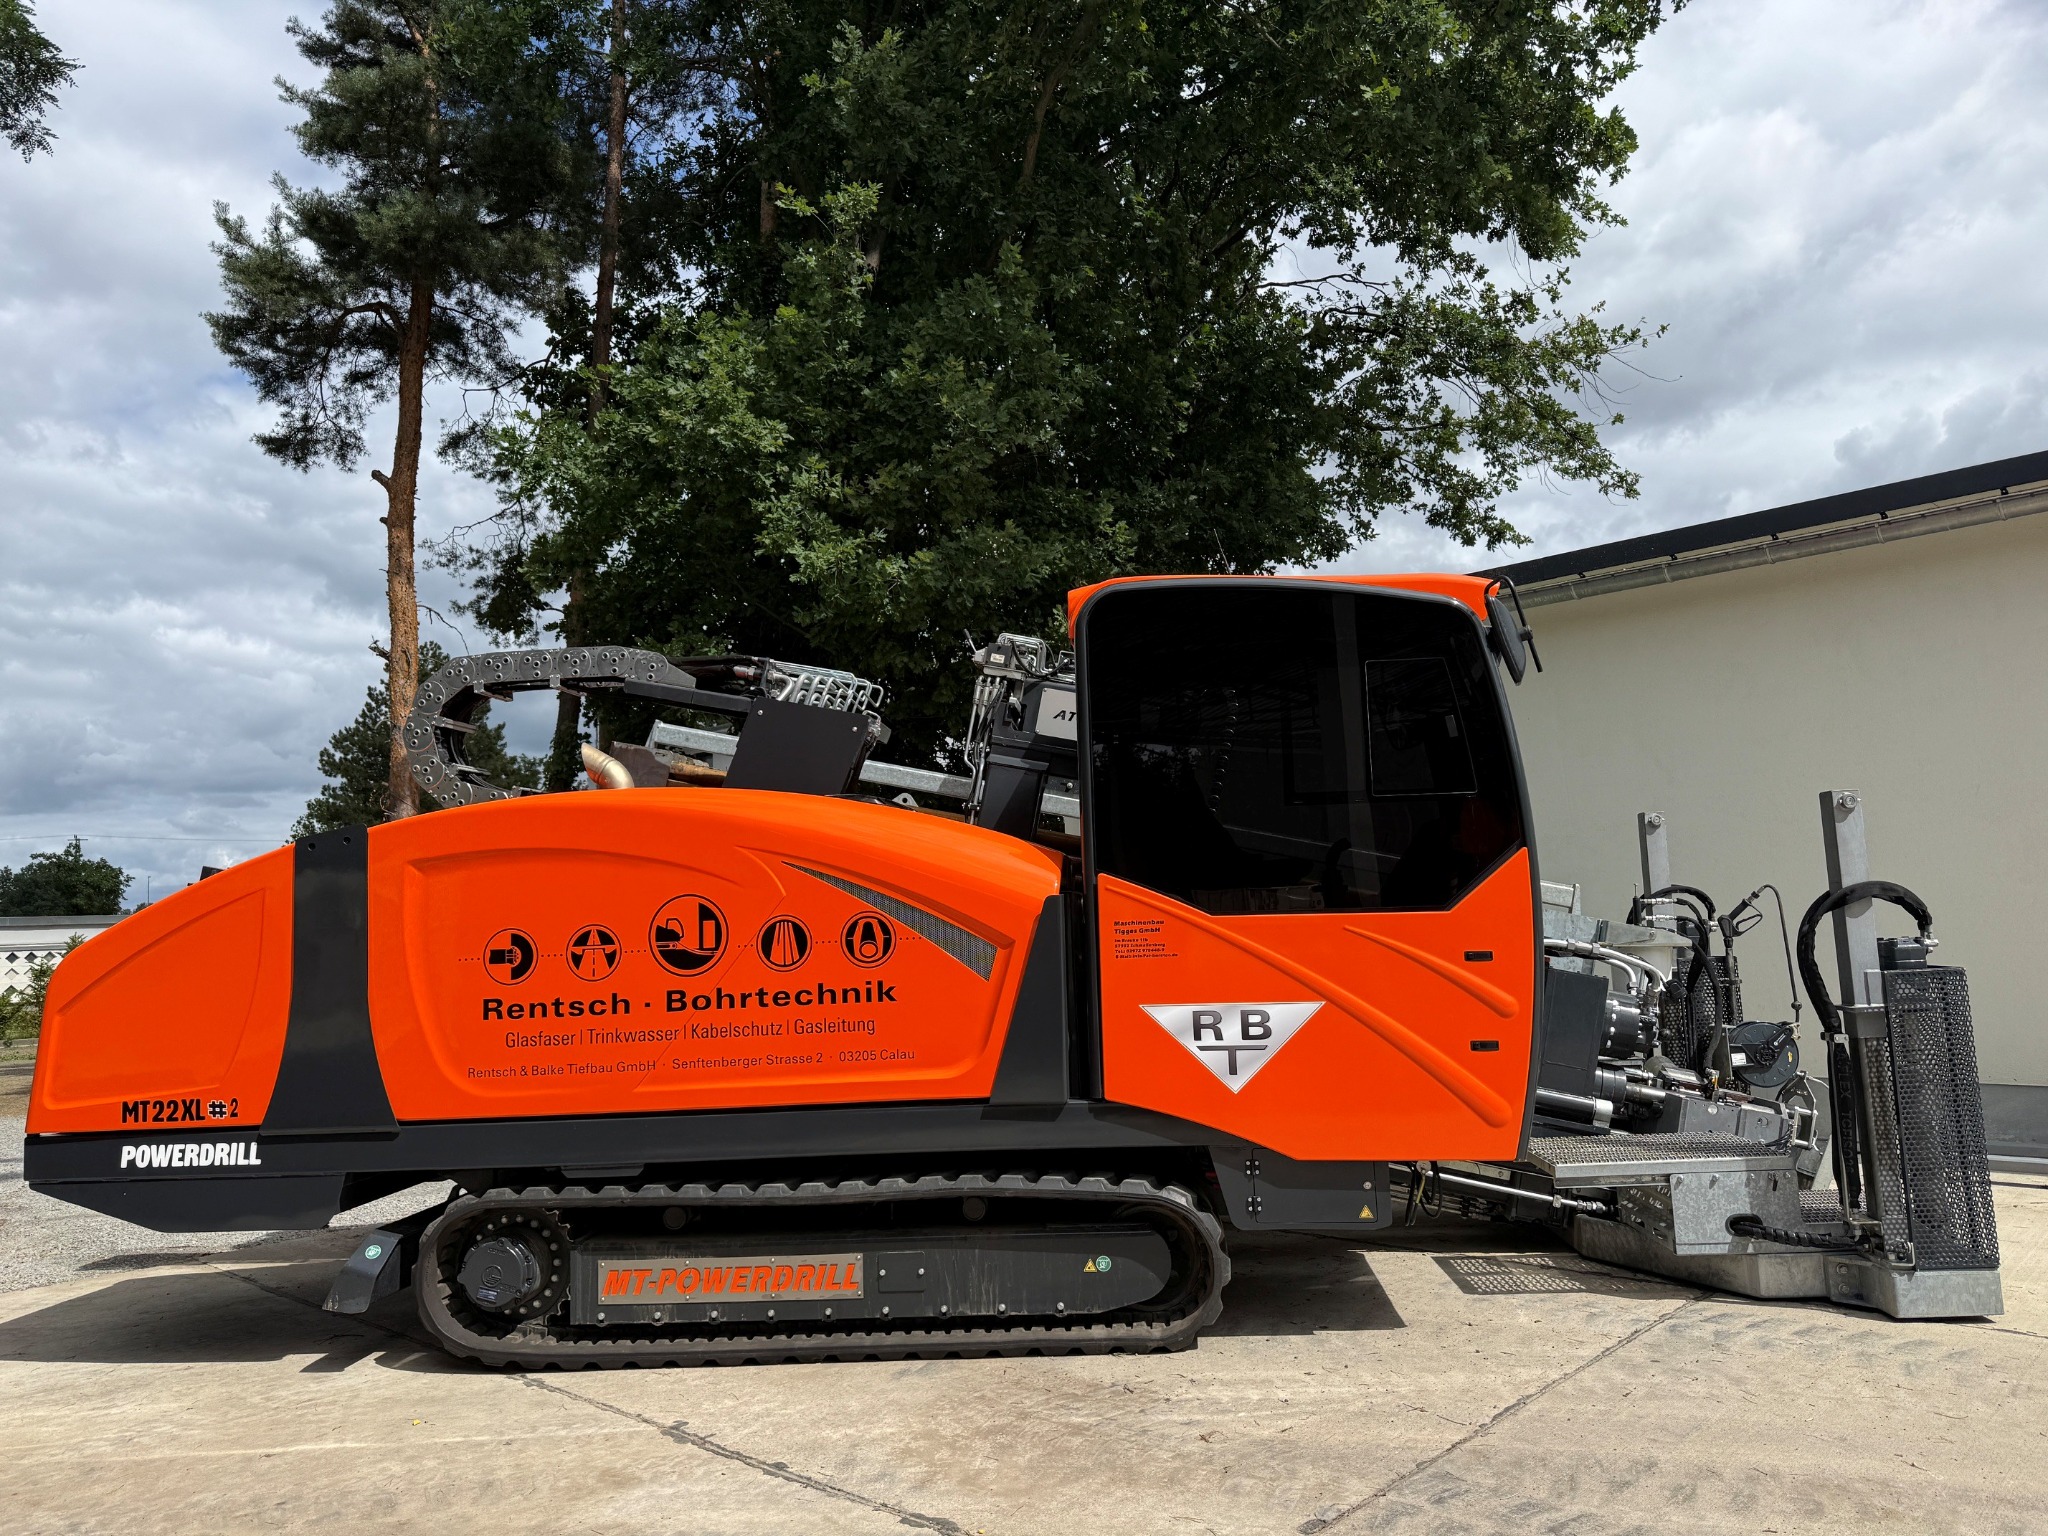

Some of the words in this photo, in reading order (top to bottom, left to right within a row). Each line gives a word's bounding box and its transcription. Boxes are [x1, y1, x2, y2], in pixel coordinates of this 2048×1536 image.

[1053, 709, 1077, 722] AT
[482, 992, 631, 1021] Rentsch
[666, 980, 897, 1013] Bohrtechnik
[504, 1028, 577, 1049] Glasfaser
[587, 1023, 680, 1046] Trinkwasser
[690, 1020, 783, 1041] Kabelschutz
[793, 1016, 876, 1037] Gasleitung
[467, 1065, 518, 1079] Rentsch
[519, 1065, 529, 1077] &
[530, 1063, 565, 1077] Balke
[567, 1061, 613, 1076] Tiefbau
[616, 1059, 656, 1073] GmbH
[672, 1055, 764, 1072] Senftenberger
[765, 1053, 813, 1067] Strasse
[815, 1053, 824, 1064] 2
[839, 1050, 877, 1063] 03205
[879, 1048, 916, 1061] Calau
[120, 1141, 262, 1169] POWERDRILL
[602, 1264, 859, 1297] MT-POWERDRILL
